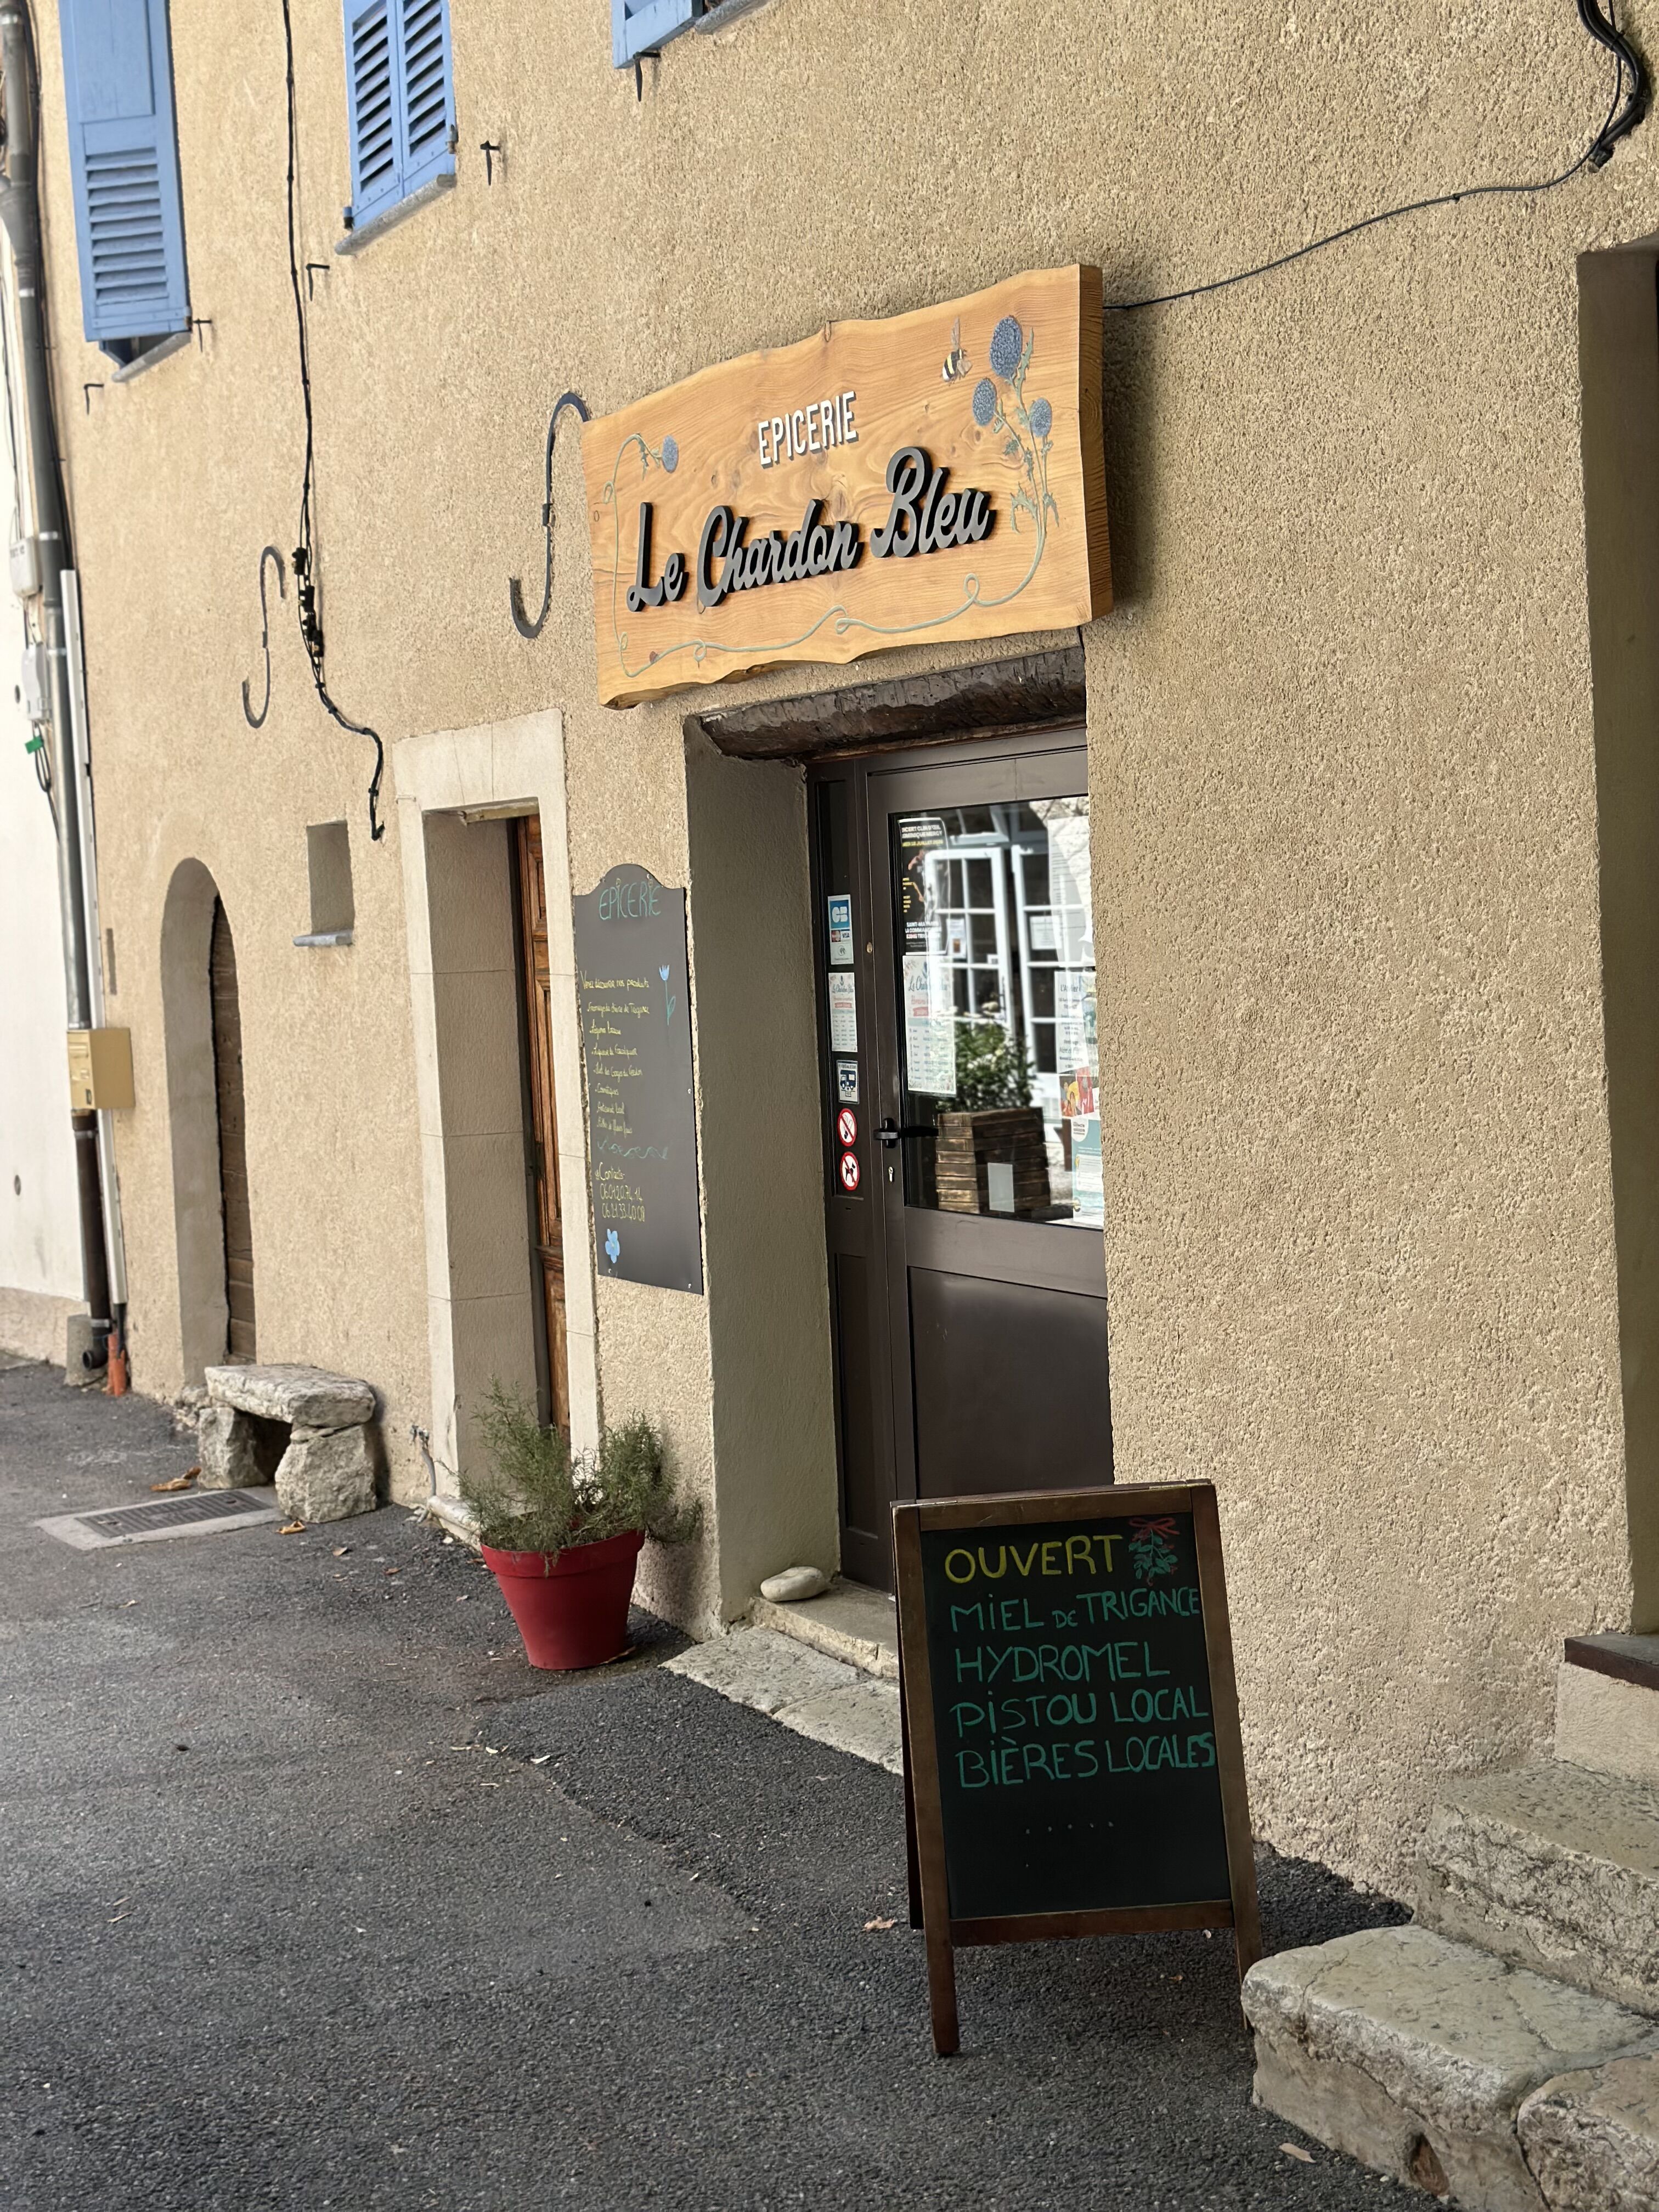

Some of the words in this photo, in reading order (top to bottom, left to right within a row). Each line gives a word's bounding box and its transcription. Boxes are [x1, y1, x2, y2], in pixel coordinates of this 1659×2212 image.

[758, 391, 858, 468] EPICERIE
[627, 501, 689, 611] Le
[697, 498, 865, 607] Chardon
[870, 447, 996, 558] Bleu
[945, 1535, 1122, 1583] OUVERT
[1076, 1587, 1200, 1624] TRIGANCE
[955, 1641, 1170, 1683] HYDROMEL
[1110, 1686, 1209, 1723] LOCAL
[1105, 1732, 1216, 1773] LOCALES
